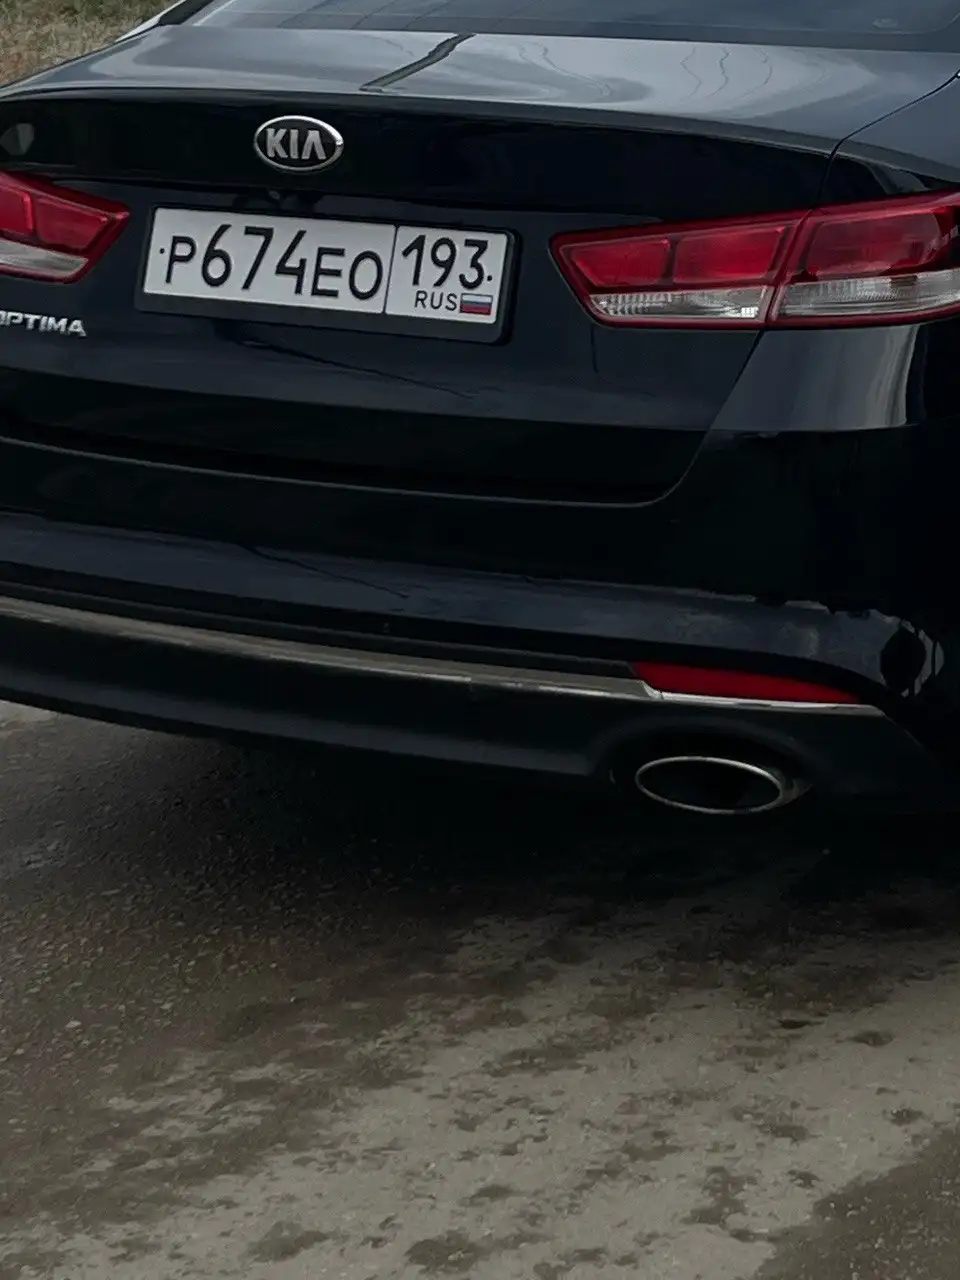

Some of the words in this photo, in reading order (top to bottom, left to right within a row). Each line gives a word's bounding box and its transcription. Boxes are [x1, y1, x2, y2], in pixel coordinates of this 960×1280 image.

[265, 127, 328, 160] KIA
[401, 234, 489, 290] 193
[414, 291, 458, 312] RUS
